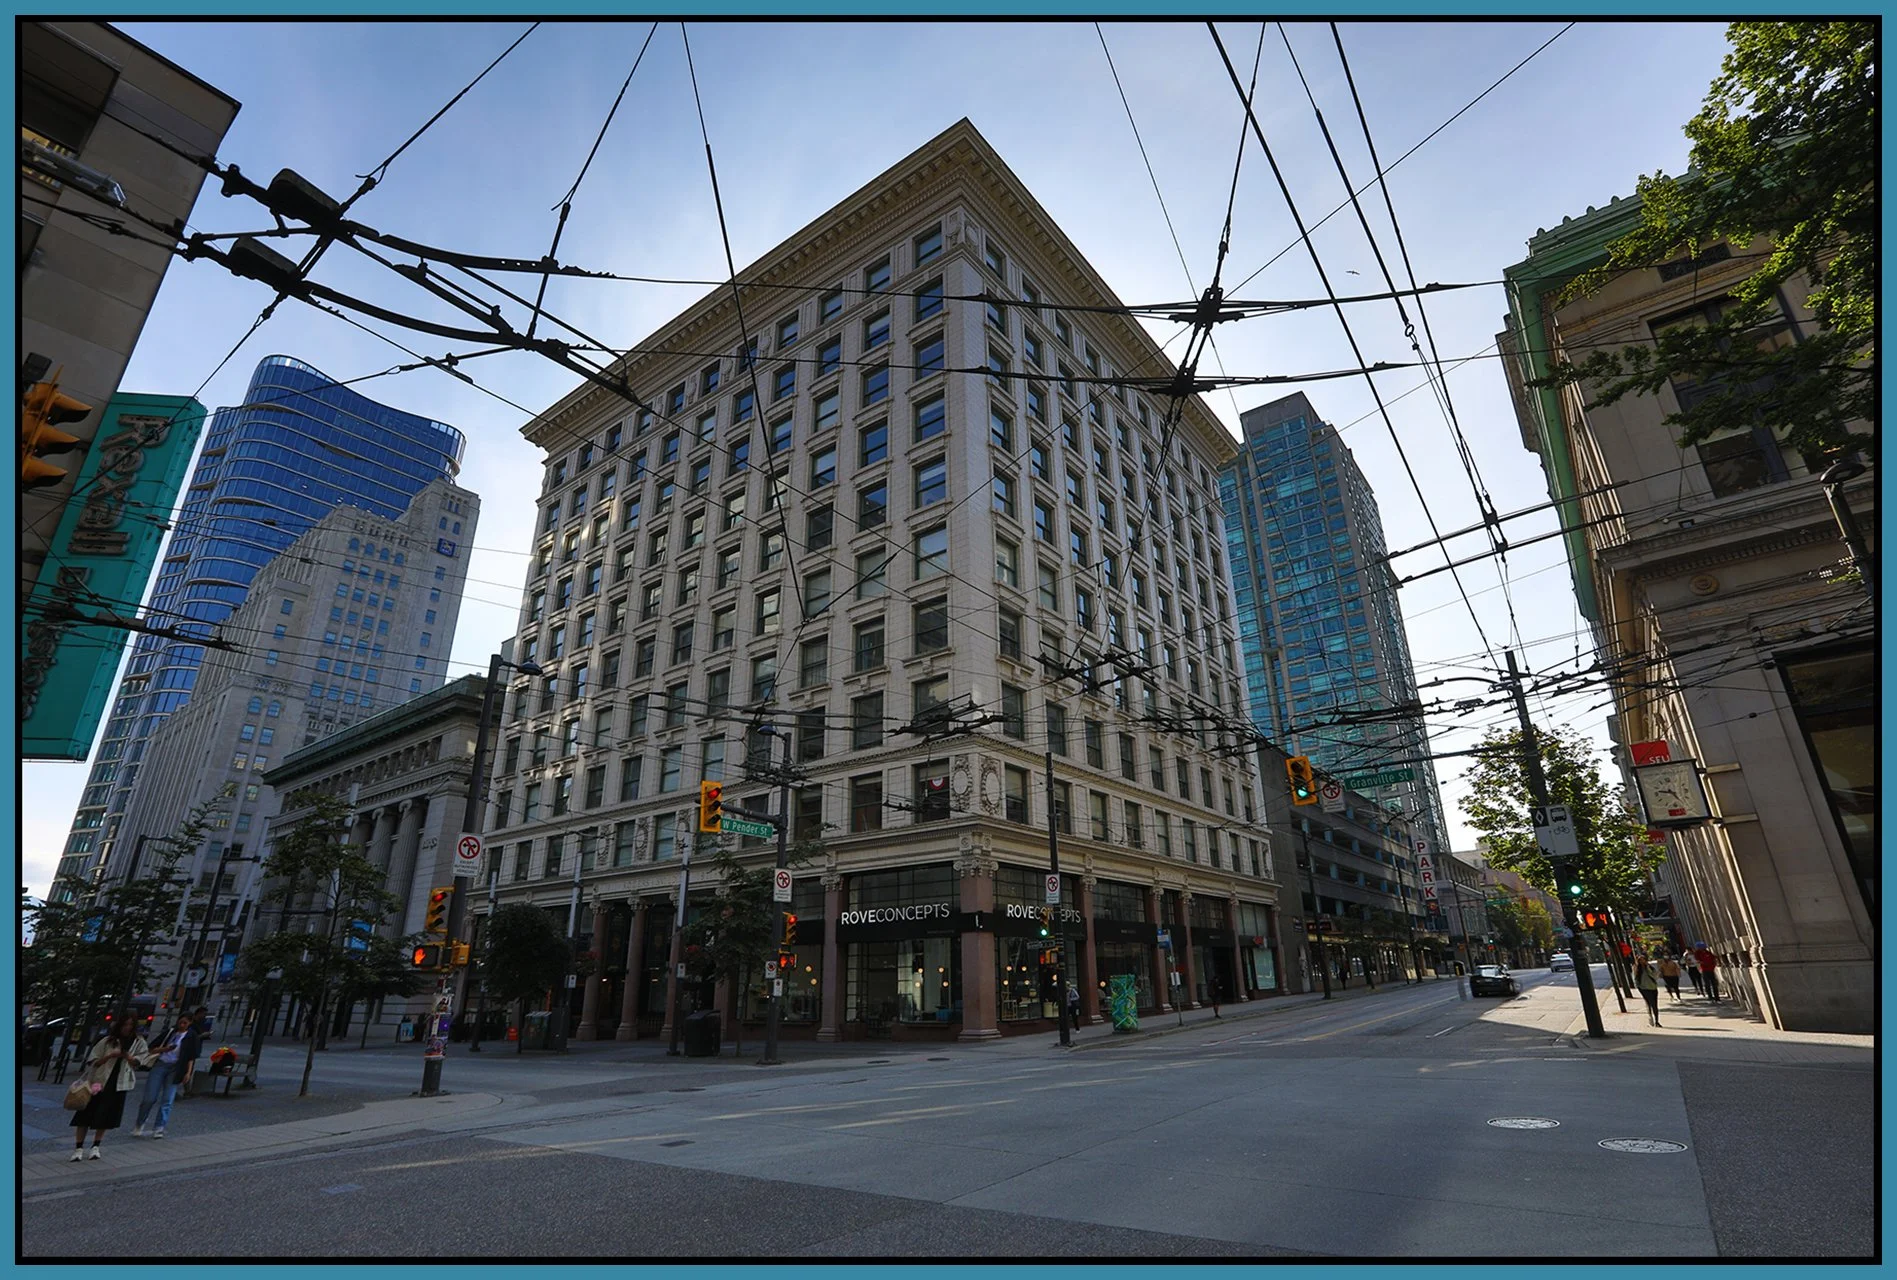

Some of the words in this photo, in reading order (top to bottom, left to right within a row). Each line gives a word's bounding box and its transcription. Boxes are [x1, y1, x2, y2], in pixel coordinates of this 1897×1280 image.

[67, 412, 171, 556] Rexall
[1350, 774, 1395, 789] Granville
[1399, 771, 1409, 781] St
[722, 820, 729, 829] W
[732, 821, 758, 834] Pender
[760, 827, 768, 836] St
[1416, 842, 1436, 898] PARK
[841, 903, 950, 925] ROVECONCEPTS
[1600, 913, 1608, 925] 4
